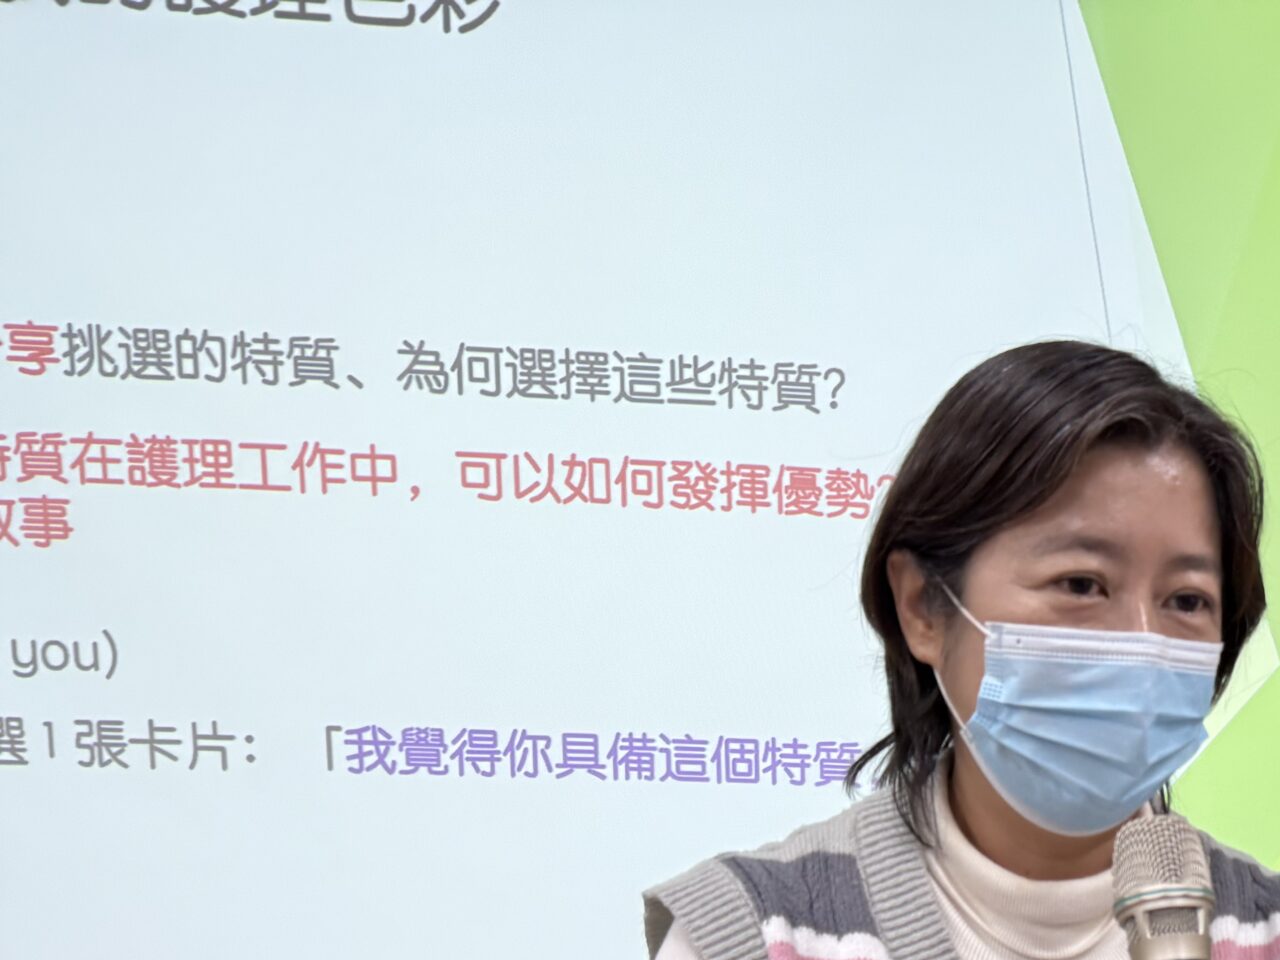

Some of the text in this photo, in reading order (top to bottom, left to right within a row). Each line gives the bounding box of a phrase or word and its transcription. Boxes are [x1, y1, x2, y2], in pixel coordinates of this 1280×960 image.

[0, 320, 846, 414] 享挑選的特質、為何選擇這些特質?
[0, 431, 898, 519] 質在護理工作中，可以如何發揮優勢
[11, 630, 118, 680] you)
